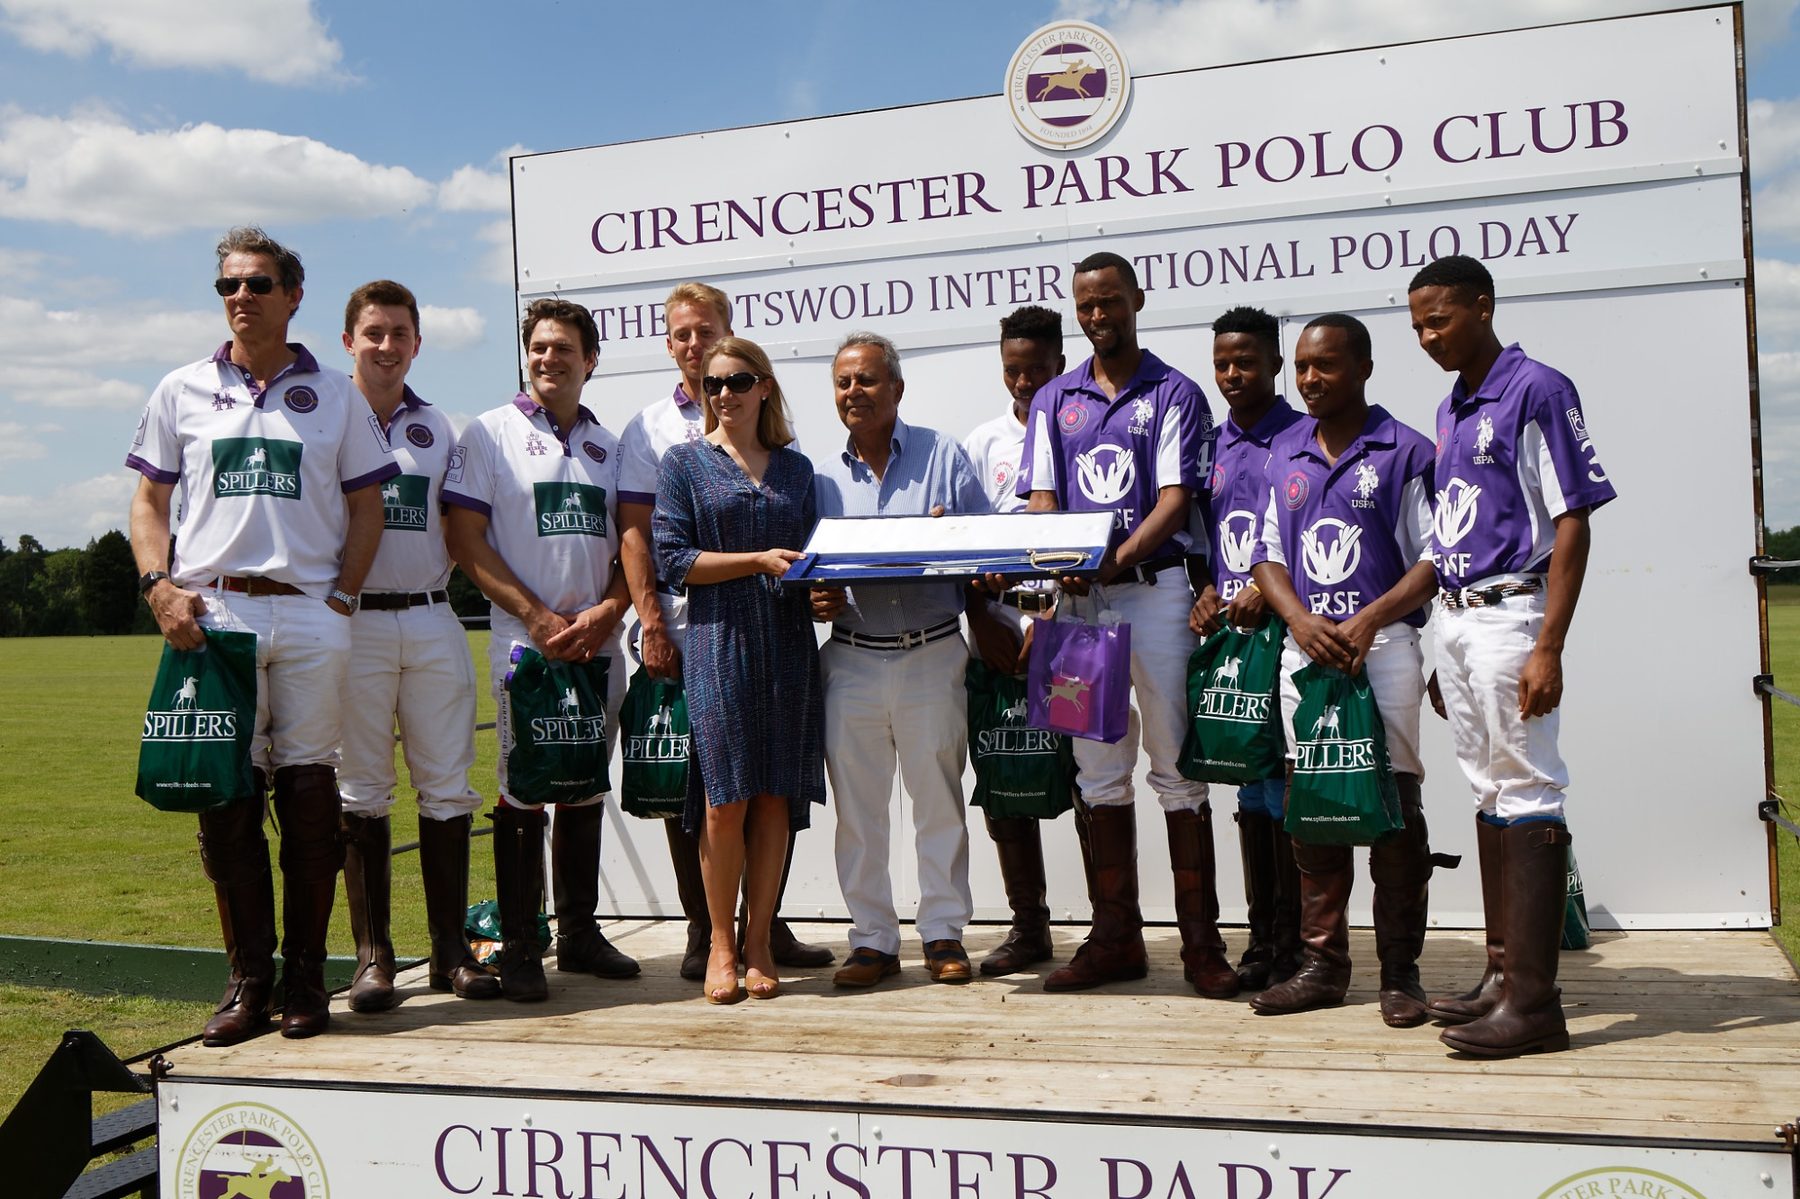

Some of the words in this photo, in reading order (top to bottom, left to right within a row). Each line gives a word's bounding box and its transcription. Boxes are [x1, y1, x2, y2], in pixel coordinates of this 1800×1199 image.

[1014, 34, 1056, 101] CIRENCESTER
[1059, 31, 1088, 43] PARK
[1090, 37, 1114, 64] POLO
[1108, 64, 1119, 95] CLUB
[1039, 126, 1078, 139] FOUNDED
[591, 171, 1000, 254] CIRENCESTER
[1022, 147, 1192, 209] PARK
[1215, 124, 1402, 188] POLO
[1433, 99, 1629, 164] CLUB
[592, 302, 668, 341] THE
[728, 280, 911, 328] TSWOLD
[929, 241, 1314, 311] INTERTIONAL
[1330, 226, 1461, 274] POLO
[1479, 213, 1579, 261] DAY
[1127, 425, 1149, 437] USPA
[1473, 455, 1495, 465] USPA
[218, 472, 296, 493] SPILLERS
[1352, 499, 1375, 509] USPA
[541, 512, 606, 532] SPILLERS
[1308, 590, 1360, 615] ERSF
[1197, 692, 1272, 720] PILLERS
[142, 711, 237, 738] SPILLERS
[531, 717, 605, 741] SPILLER
[977, 730, 1062, 755] SPILLERS
[1294, 742, 1376, 769] PILLERS
[183, 1112, 237, 1199] IRENCESTER
[240, 1111, 278, 1131] PARK
[281, 1125, 313, 1168] POLO
[434, 1124, 1060, 1199] CIRENCESTER
[1609, 1178, 1673, 1199] PARK
